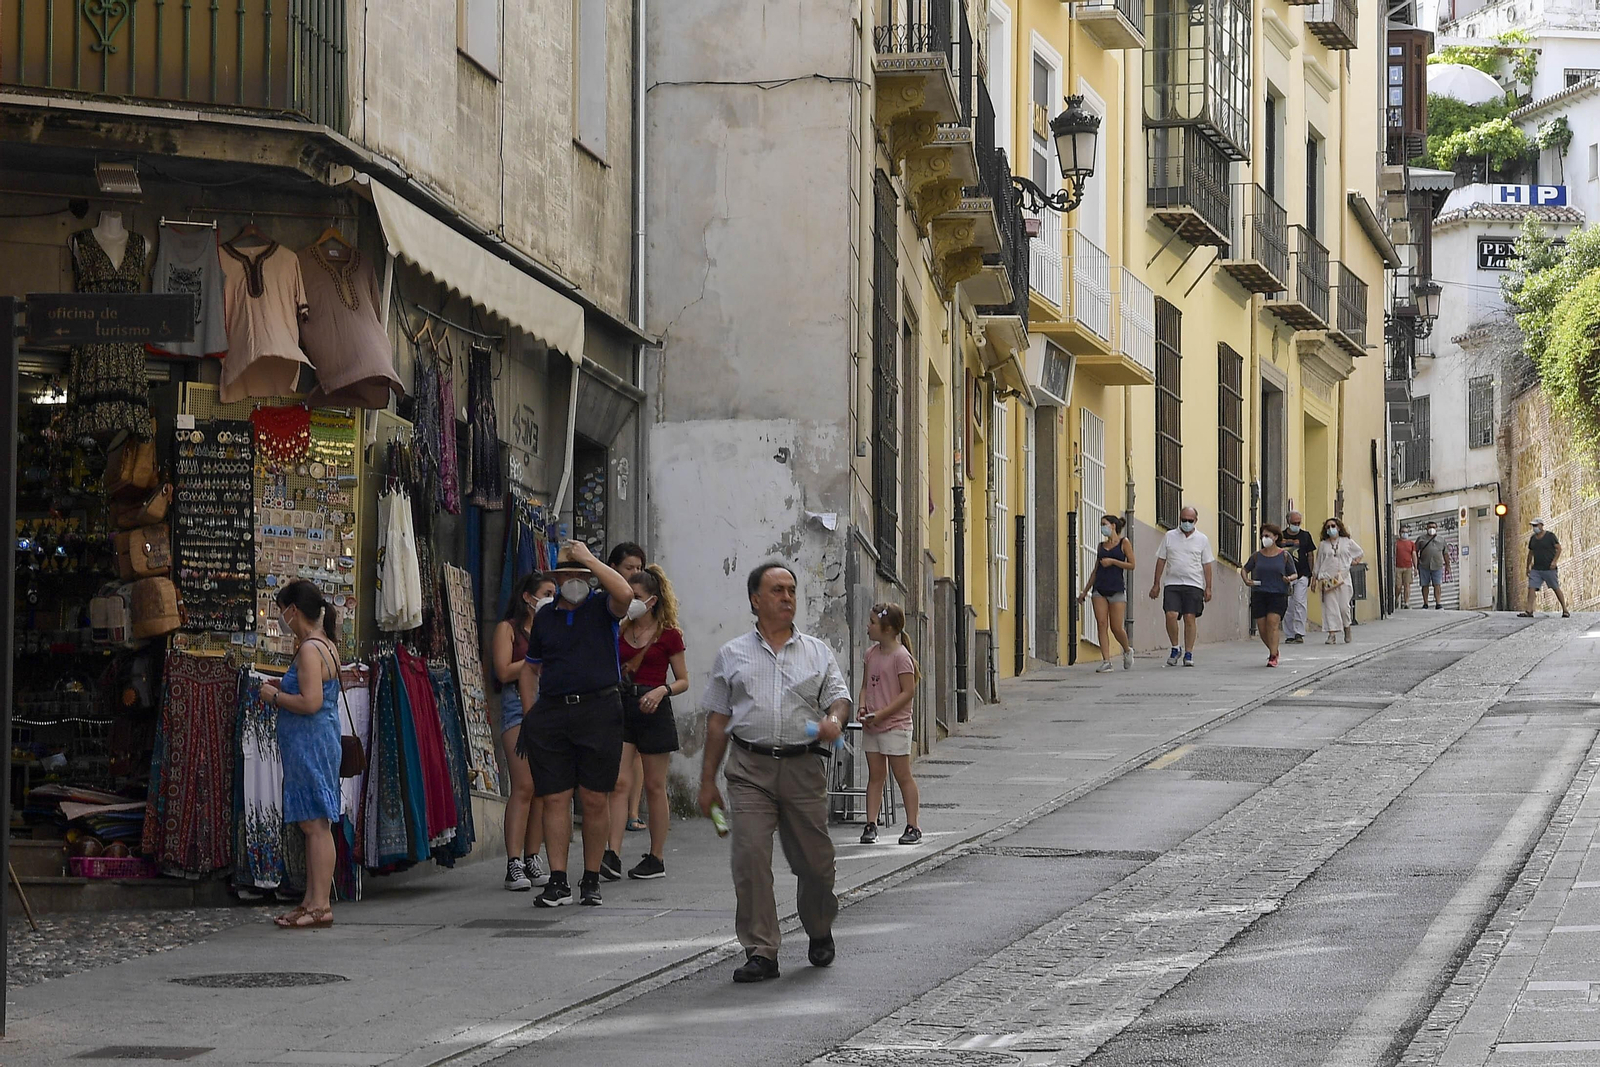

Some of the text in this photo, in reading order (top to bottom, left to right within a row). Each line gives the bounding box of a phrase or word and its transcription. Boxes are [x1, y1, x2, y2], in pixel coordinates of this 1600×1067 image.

[47, 306, 118, 320] oficina de
[95, 320, 151, 337] turismo
